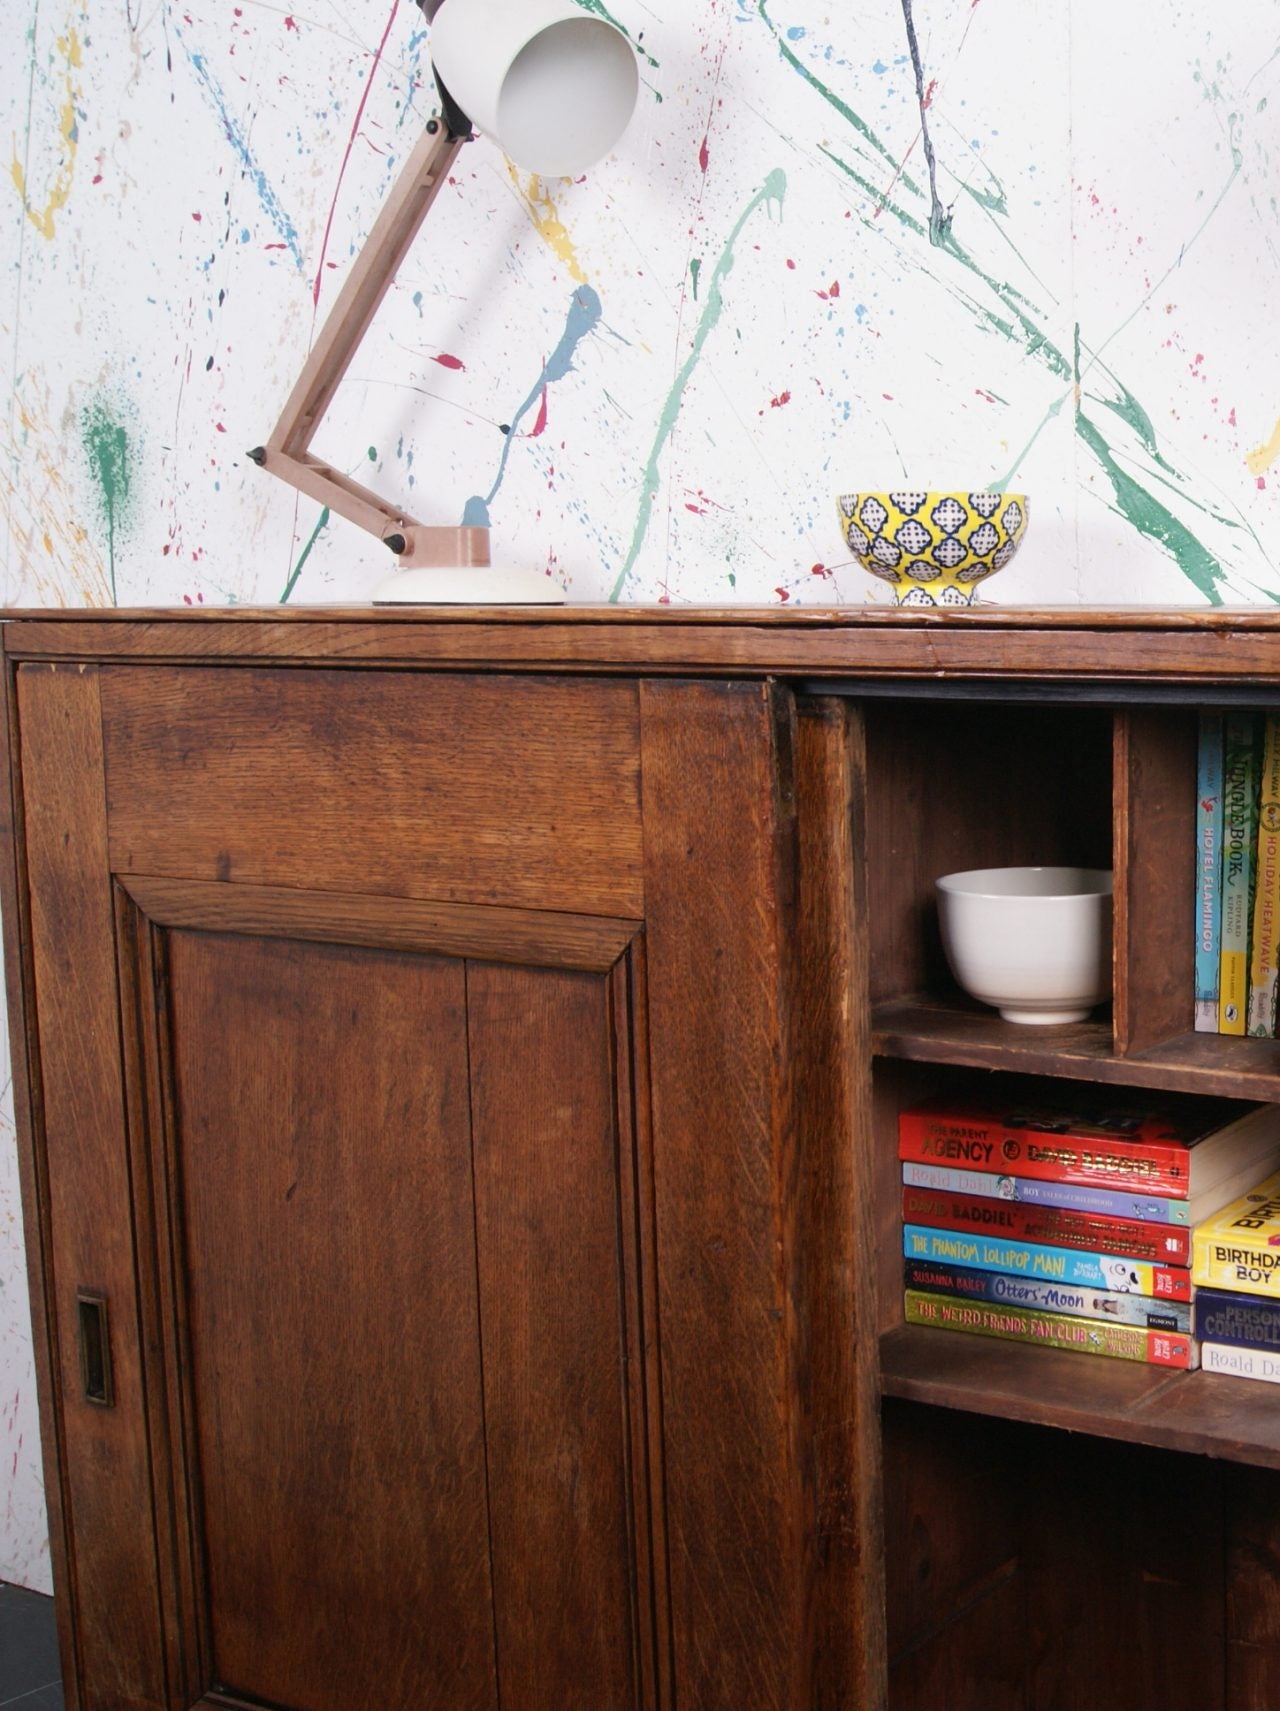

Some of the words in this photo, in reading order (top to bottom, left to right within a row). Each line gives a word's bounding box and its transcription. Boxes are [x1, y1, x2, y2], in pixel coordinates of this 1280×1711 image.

[1273, 731, 1280, 756] ALEX
[1229, 757, 1249, 826] JUNGLE
[1271, 758, 1280, 797] MILWAY
[1203, 828, 1214, 873] HOTEL
[1227, 829, 1246, 886] BOOK
[1266, 836, 1277, 898] HOLIDAY
[1202, 878, 1214, 952] FLAMINGO
[1226, 896, 1234, 934] KIPLING
[1234, 894, 1243, 938] RUDYARD
[1258, 903, 1274, 974] HEATWAVE
[950, 1126, 989, 1140] PARENT
[922, 1137, 994, 1163] AGENCY
[1082, 1151, 1160, 1177] BADDIEL
[911, 1168, 949, 1187] Roald
[958, 1174, 993, 1193] Dahl
[1024, 1187, 1039, 1197] BOY
[909, 1198, 948, 1216] DAVID
[951, 1204, 1014, 1227] BADDIEL
[911, 1234, 928, 1253] THE
[932, 1238, 979, 1263] PHANTOM
[983, 1244, 1030, 1269] LOLLIPOP
[1032, 1252, 1067, 1277] MAN!
[1236, 1265, 1272, 1283] BOY
[912, 1271, 953, 1287] SUSANNA
[956, 1277, 987, 1292] BAILEY
[1040, 1289, 1084, 1308] Moon
[917, 1301, 937, 1320] THE
[1030, 1319, 1053, 1338] FAN
[1056, 1324, 1088, 1343] CLUB
[1209, 1351, 1253, 1373] Roald
